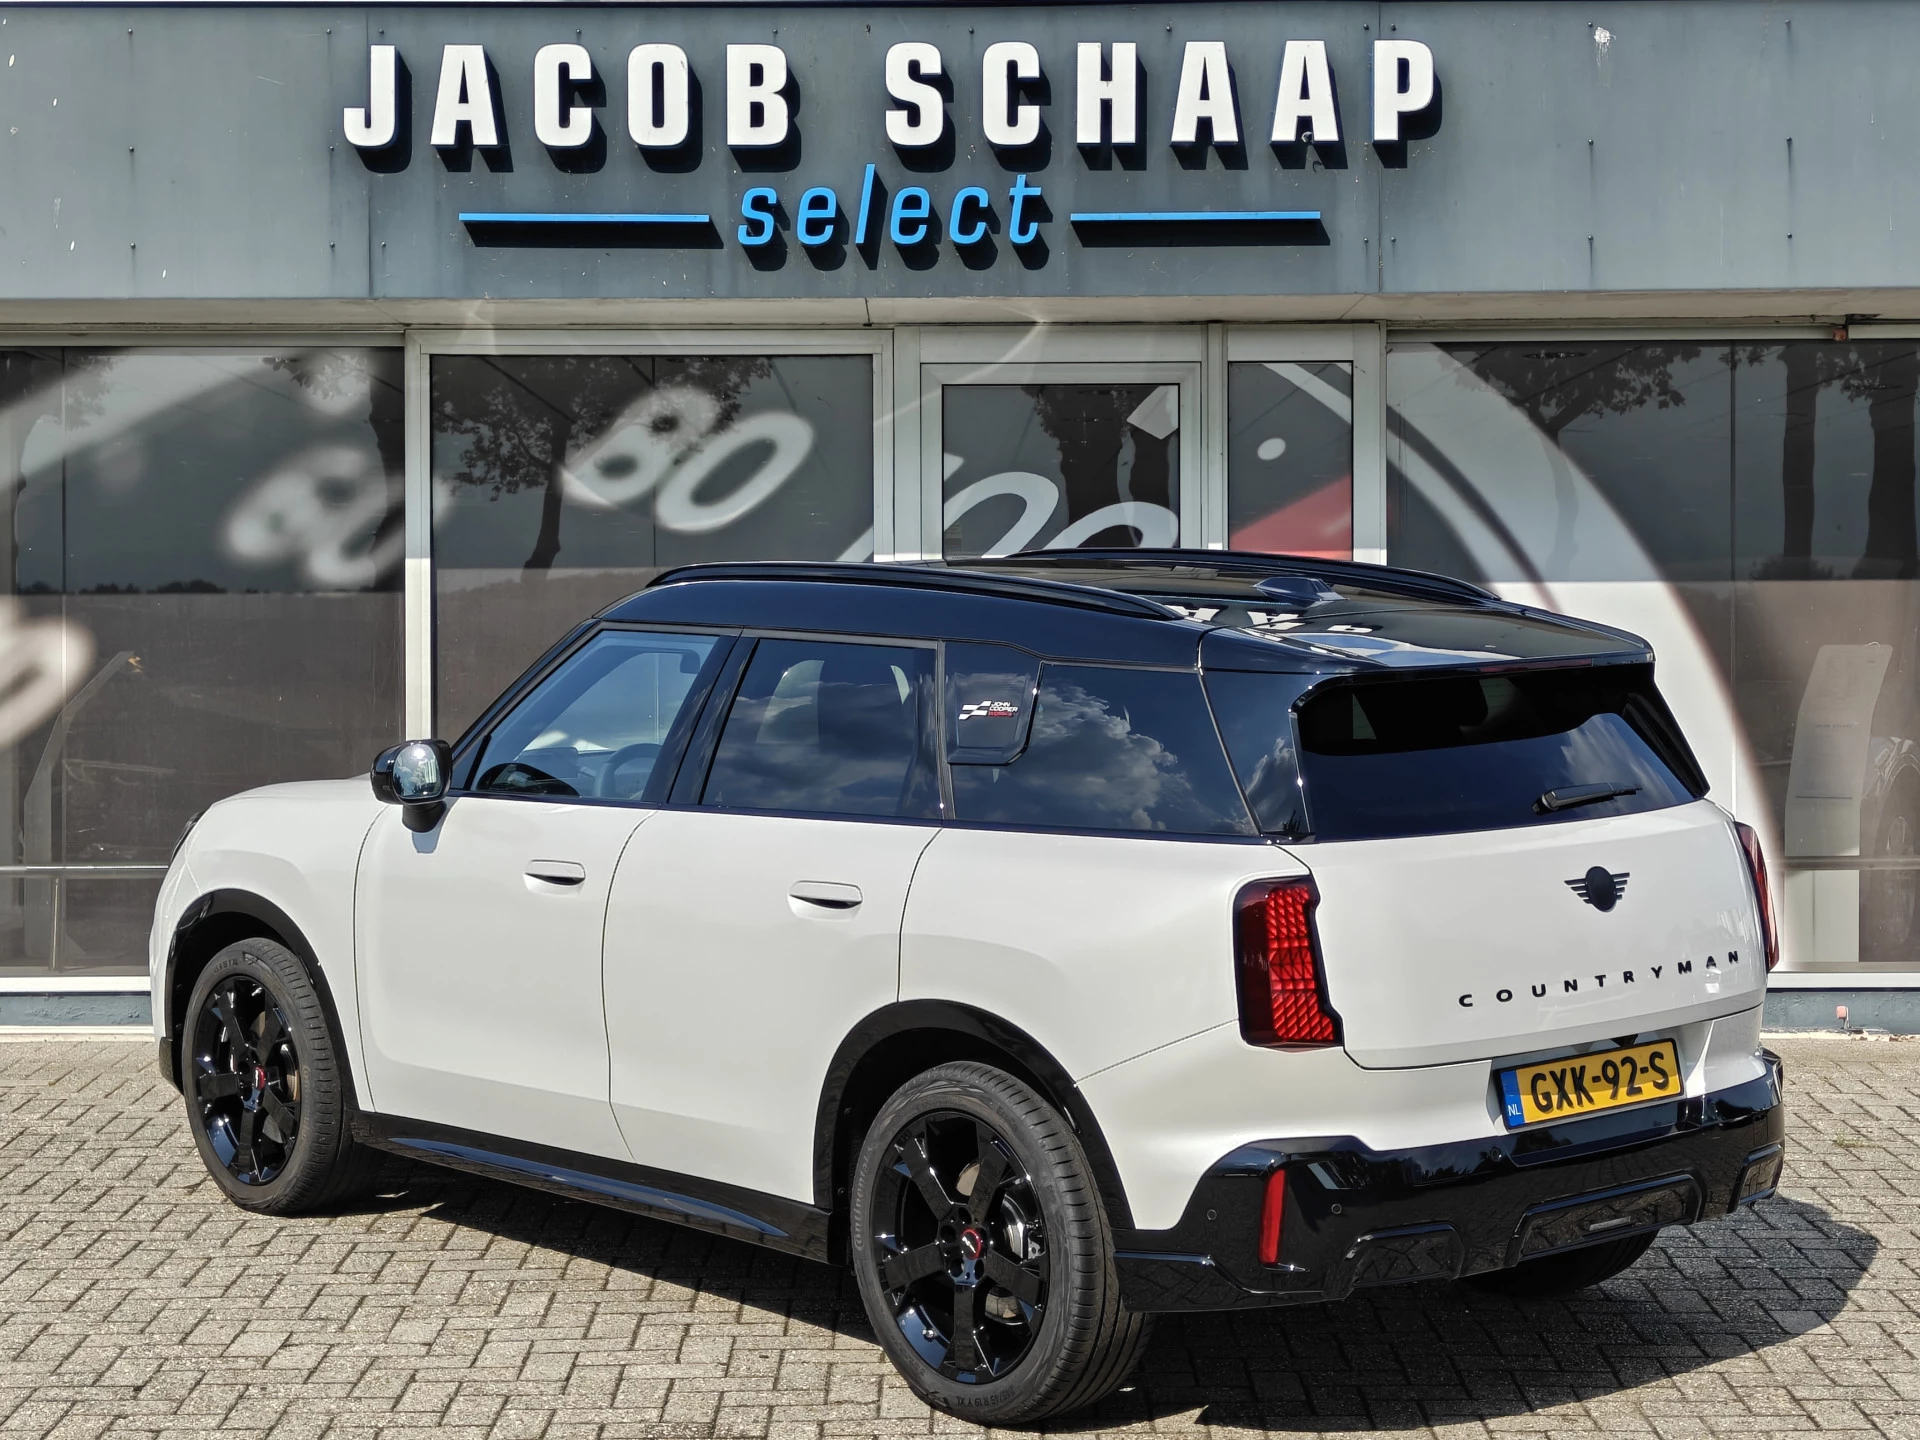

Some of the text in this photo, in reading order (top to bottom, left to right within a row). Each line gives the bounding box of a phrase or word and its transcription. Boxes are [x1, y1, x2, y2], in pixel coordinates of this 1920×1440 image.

[343, 40, 1434, 147] JACOB SCHAAP
[737, 163, 1042, 245] select
[1459, 950, 1739, 1008] COUNTRYMAN
[1507, 1104, 1521, 1117] NL
[1530, 1051, 1670, 1114] GXK-92-S
